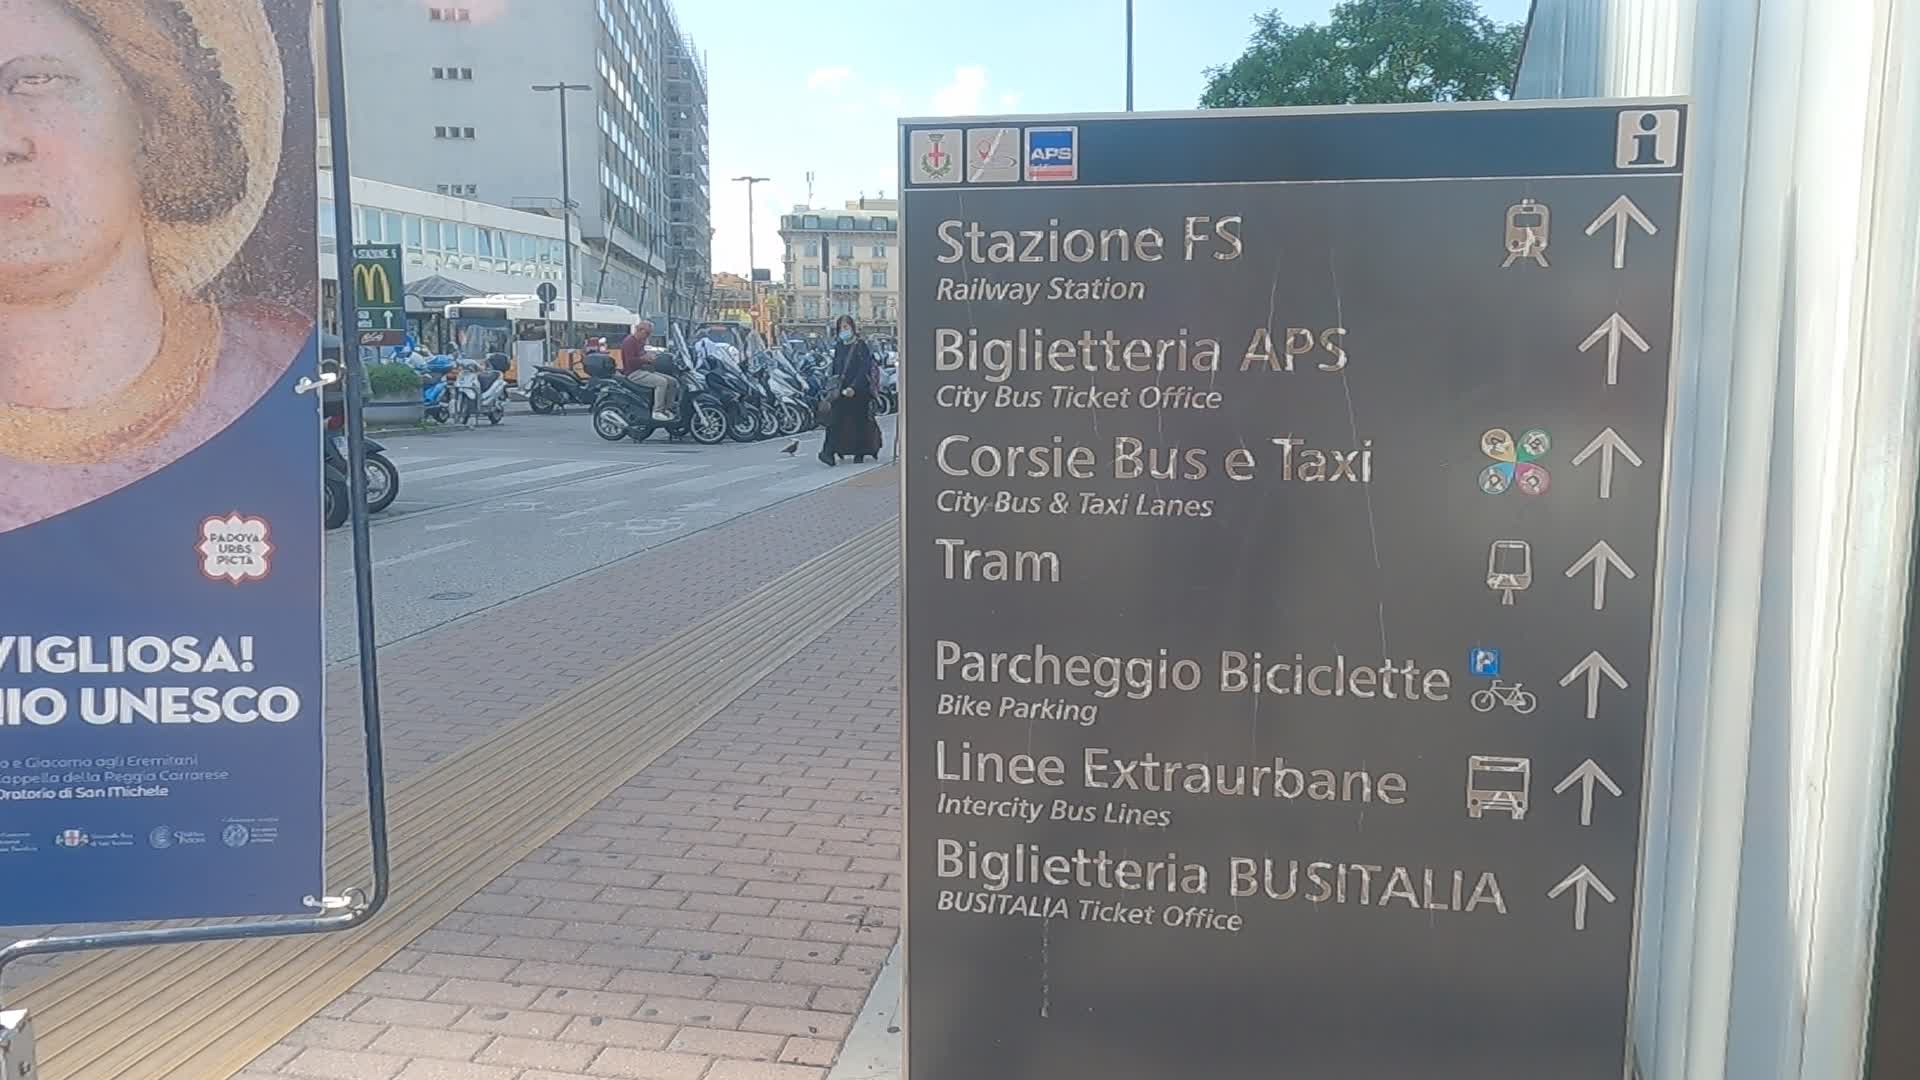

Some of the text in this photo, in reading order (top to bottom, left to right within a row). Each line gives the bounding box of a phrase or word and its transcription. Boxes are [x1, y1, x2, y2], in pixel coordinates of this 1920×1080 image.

[1031, 147, 1072, 161] APS
[936, 215, 1243, 263] Stazione FS
[936, 277, 1146, 305] Railway Station
[934, 327, 1349, 383] Biglietteria APS
[936, 385, 1223, 413] City Bus Ticket Office
[936, 434, 1374, 483] Corsie Bus e Taxi
[936, 489, 1215, 519] City Bus & Taxi Lanes
[209, 533, 260, 542] PADOVA
[218, 544, 252, 553] URBS
[216, 555, 254, 565] PICTA
[935, 538, 1061, 583] Tram
[935, 640, 1202, 699] Parcheggio
[1220, 650, 1452, 701] Biciclette
[0, 685, 301, 725] IO UNESCO
[937, 694, 1098, 727] Bike Parking
[0, 770, 229, 785] appella della Reggia Carrarese
[13, 758, 22, 768] e
[25, 757, 92, 769] Giacomo
[95, 756, 124, 771] agli
[127, 754, 198, 767] Eremitani
[935, 740, 1408, 805] Linee Extraurbane
[58, 786, 73, 799] di
[76, 786, 105, 799] San
[107, 784, 169, 798] Michele
[937, 792, 1172, 827] Intercity Bus Lines
[936, 839, 1507, 914] Biglietteria BUSITALIA
[937, 891, 1243, 931] BUSITALIA Ticket Office
